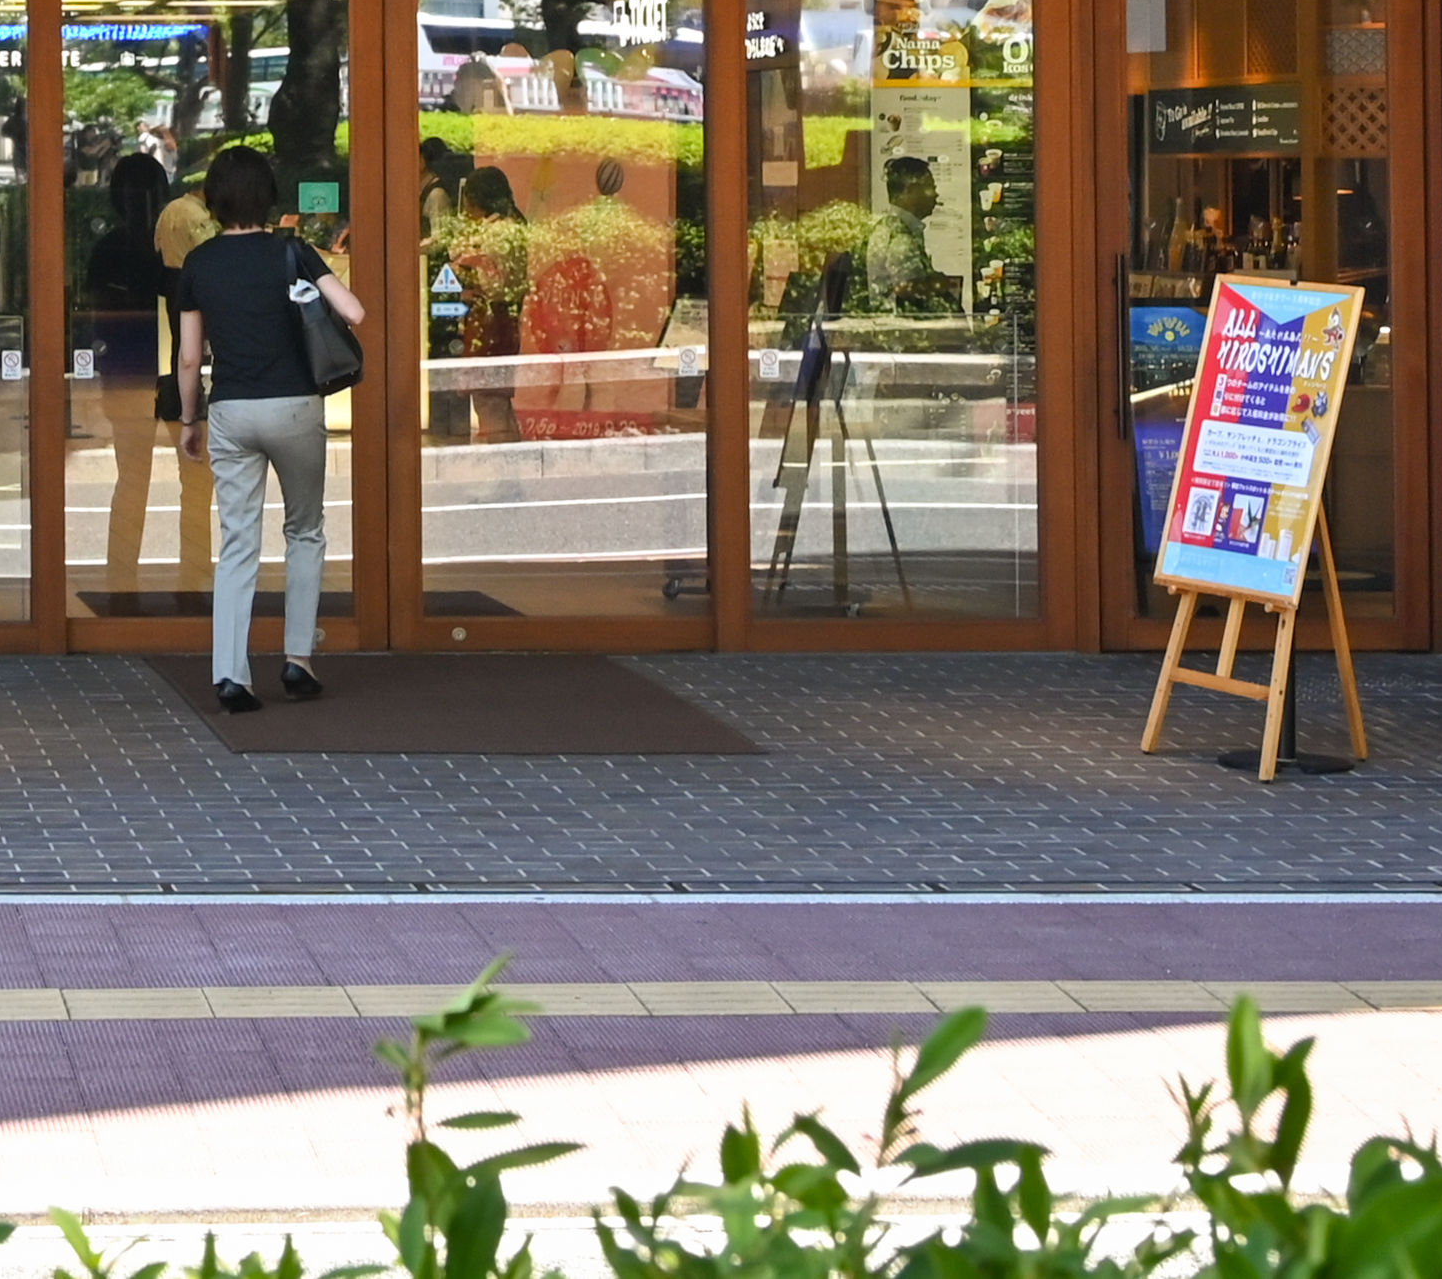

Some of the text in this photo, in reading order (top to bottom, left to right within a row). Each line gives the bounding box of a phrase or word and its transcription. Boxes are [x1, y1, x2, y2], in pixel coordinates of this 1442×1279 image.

[895, 38, 941, 51] Nama
[882, 49, 956, 74] Chips
[1221, 307, 1257, 339] ALL
